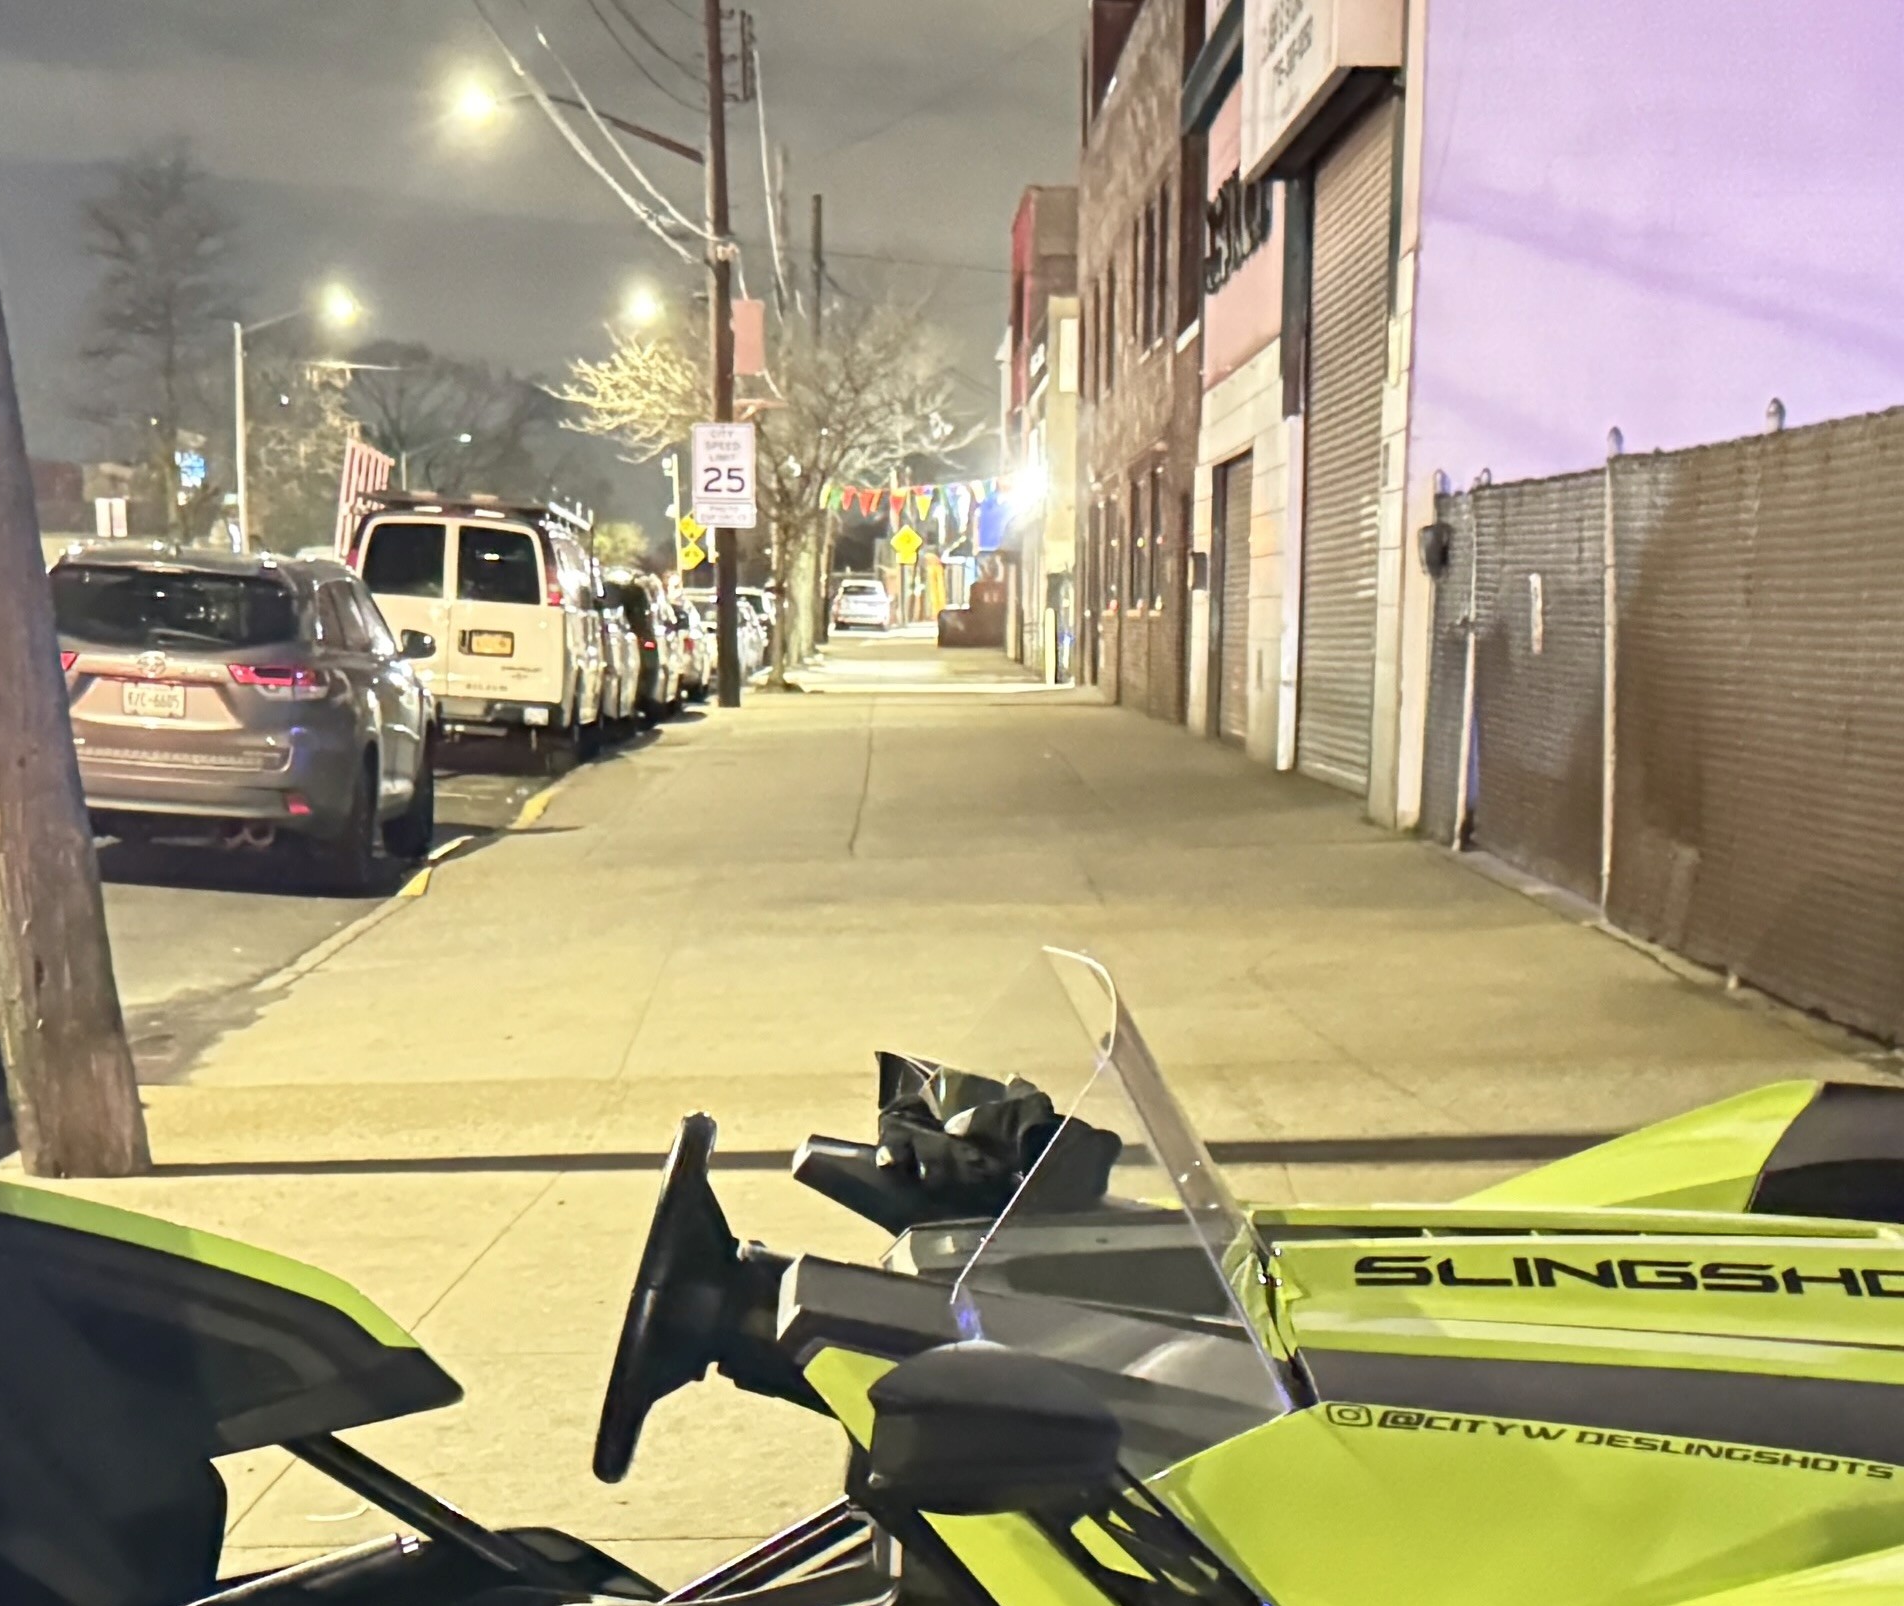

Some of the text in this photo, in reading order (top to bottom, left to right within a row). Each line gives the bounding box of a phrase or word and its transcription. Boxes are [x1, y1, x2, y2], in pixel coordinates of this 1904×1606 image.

[704, 441, 741, 451] SPEED
[703, 467, 745, 493] 25
[1575, 1430, 1894, 1480] DESLINGSHOTS
